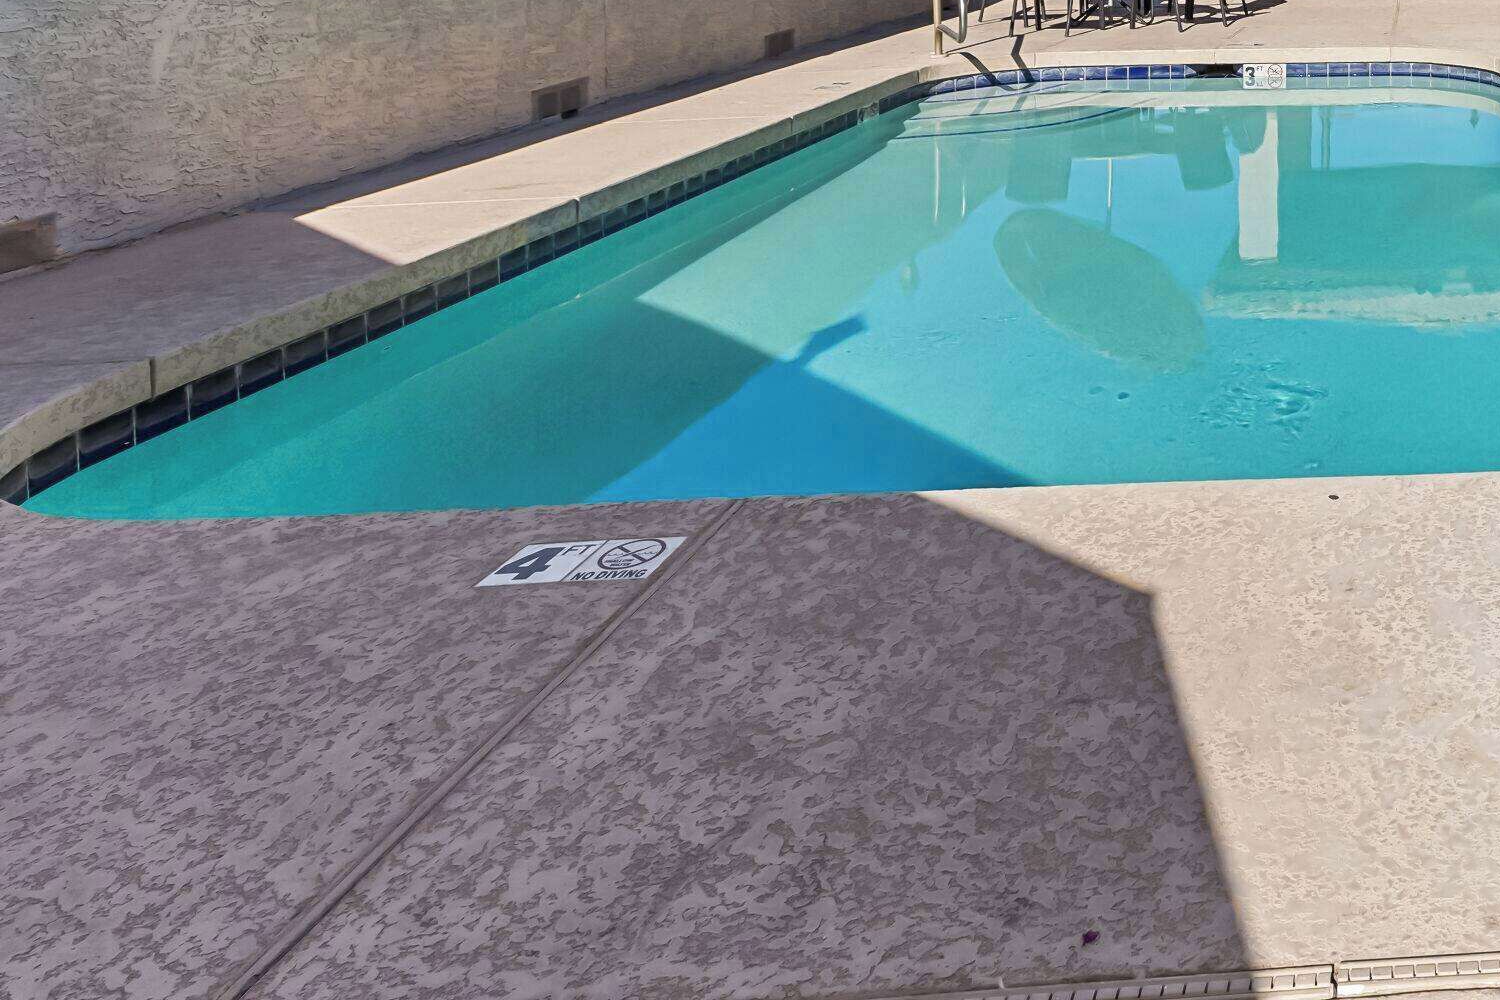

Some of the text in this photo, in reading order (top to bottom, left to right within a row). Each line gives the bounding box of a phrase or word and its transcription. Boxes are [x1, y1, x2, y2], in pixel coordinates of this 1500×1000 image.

[494, 544, 597, 581] 4 FT
[570, 569, 648, 581] NO DIVING
